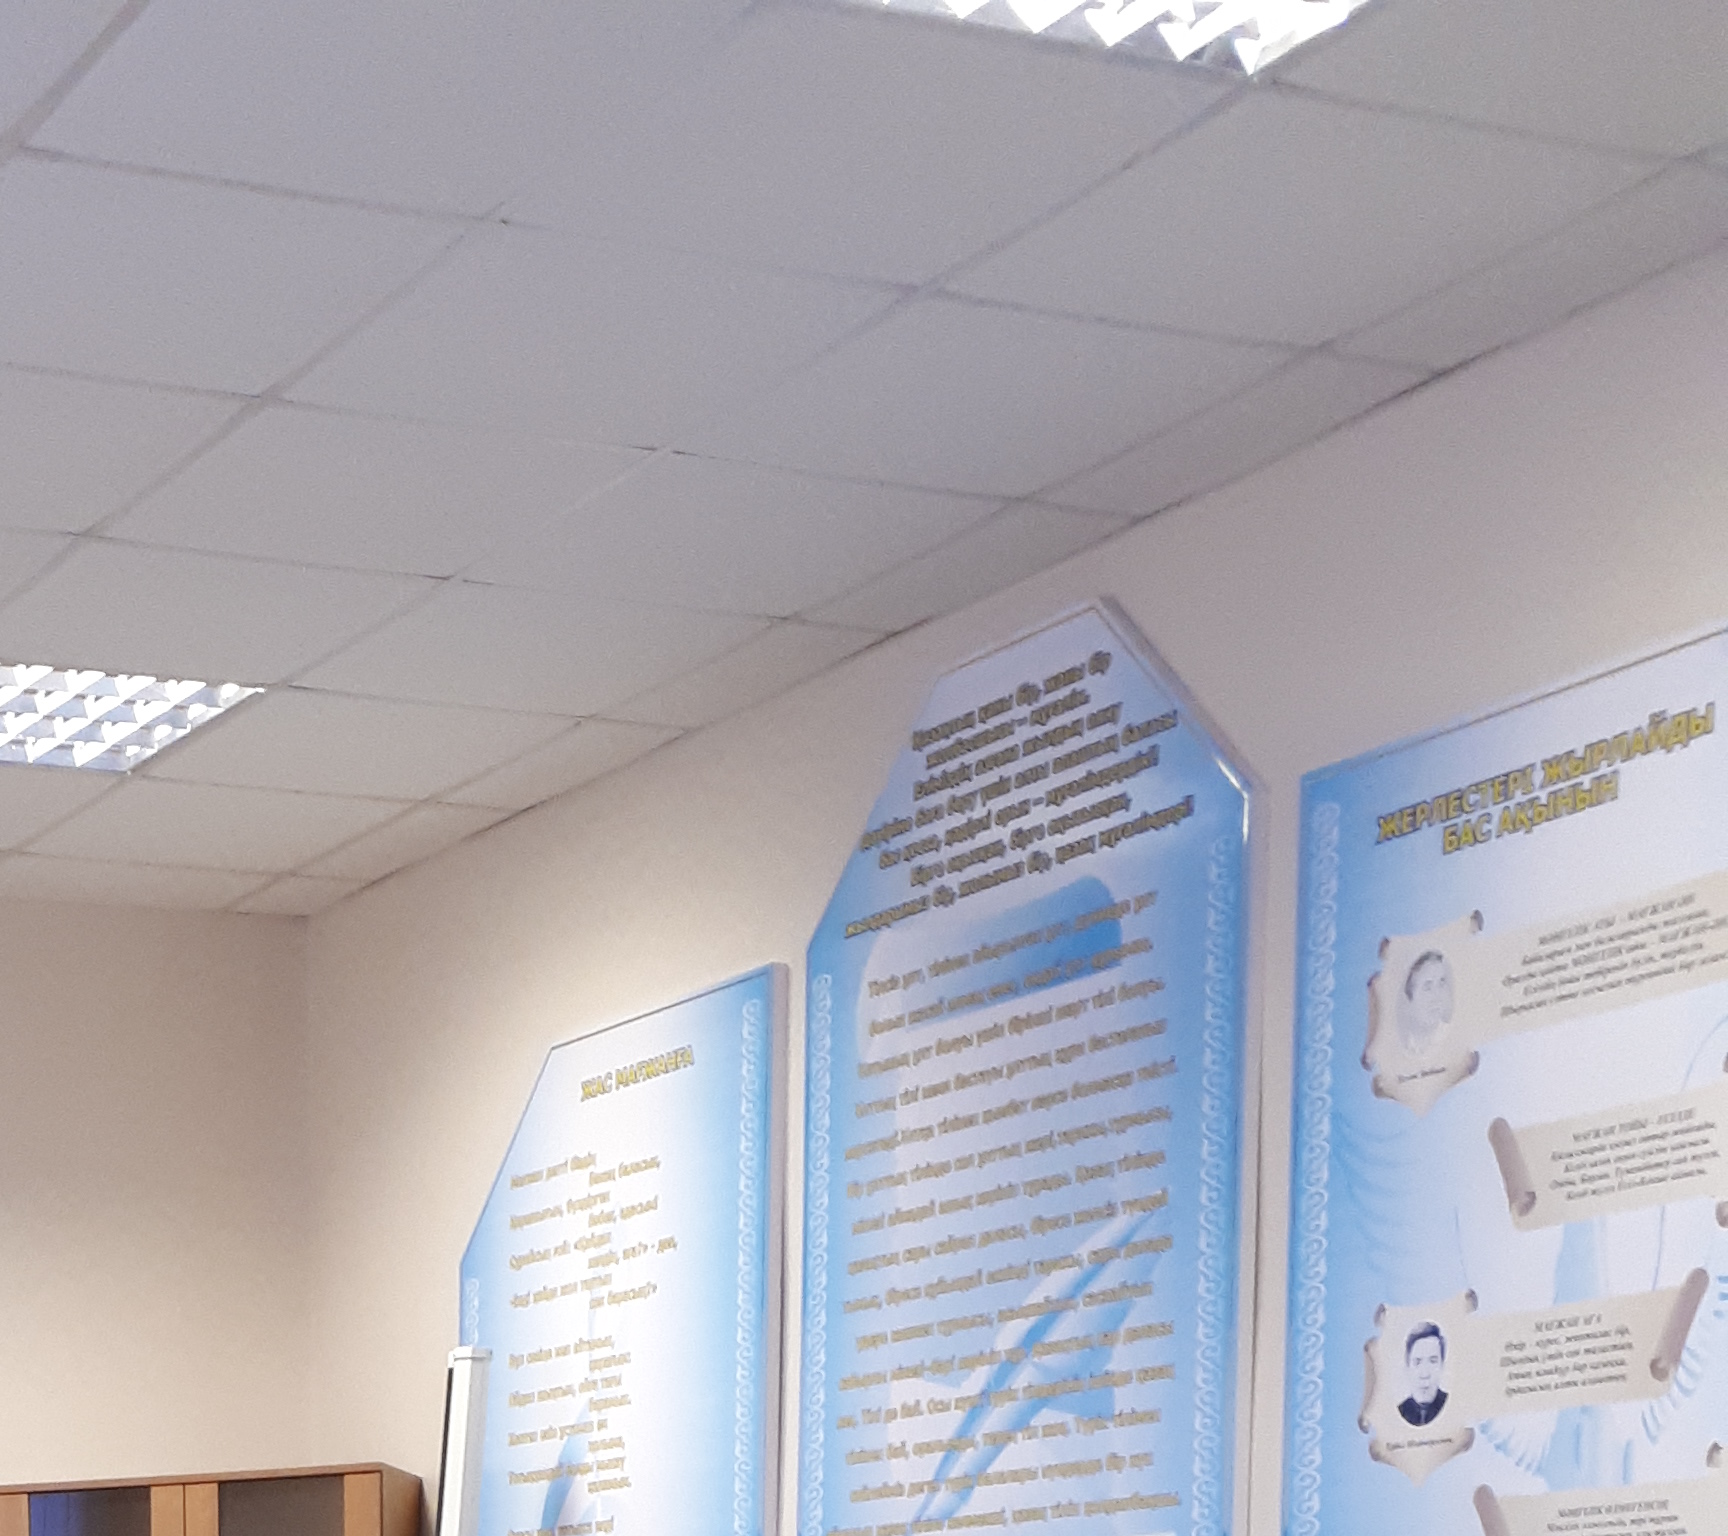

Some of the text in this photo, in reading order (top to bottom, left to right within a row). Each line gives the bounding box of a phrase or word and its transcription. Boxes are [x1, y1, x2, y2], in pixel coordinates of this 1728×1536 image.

[1375, 701, 1715, 846] ЖЕРЛЕСТЕРІ ЖЫРЛАЙДЫ
[1442, 812, 1493, 855] БАС
